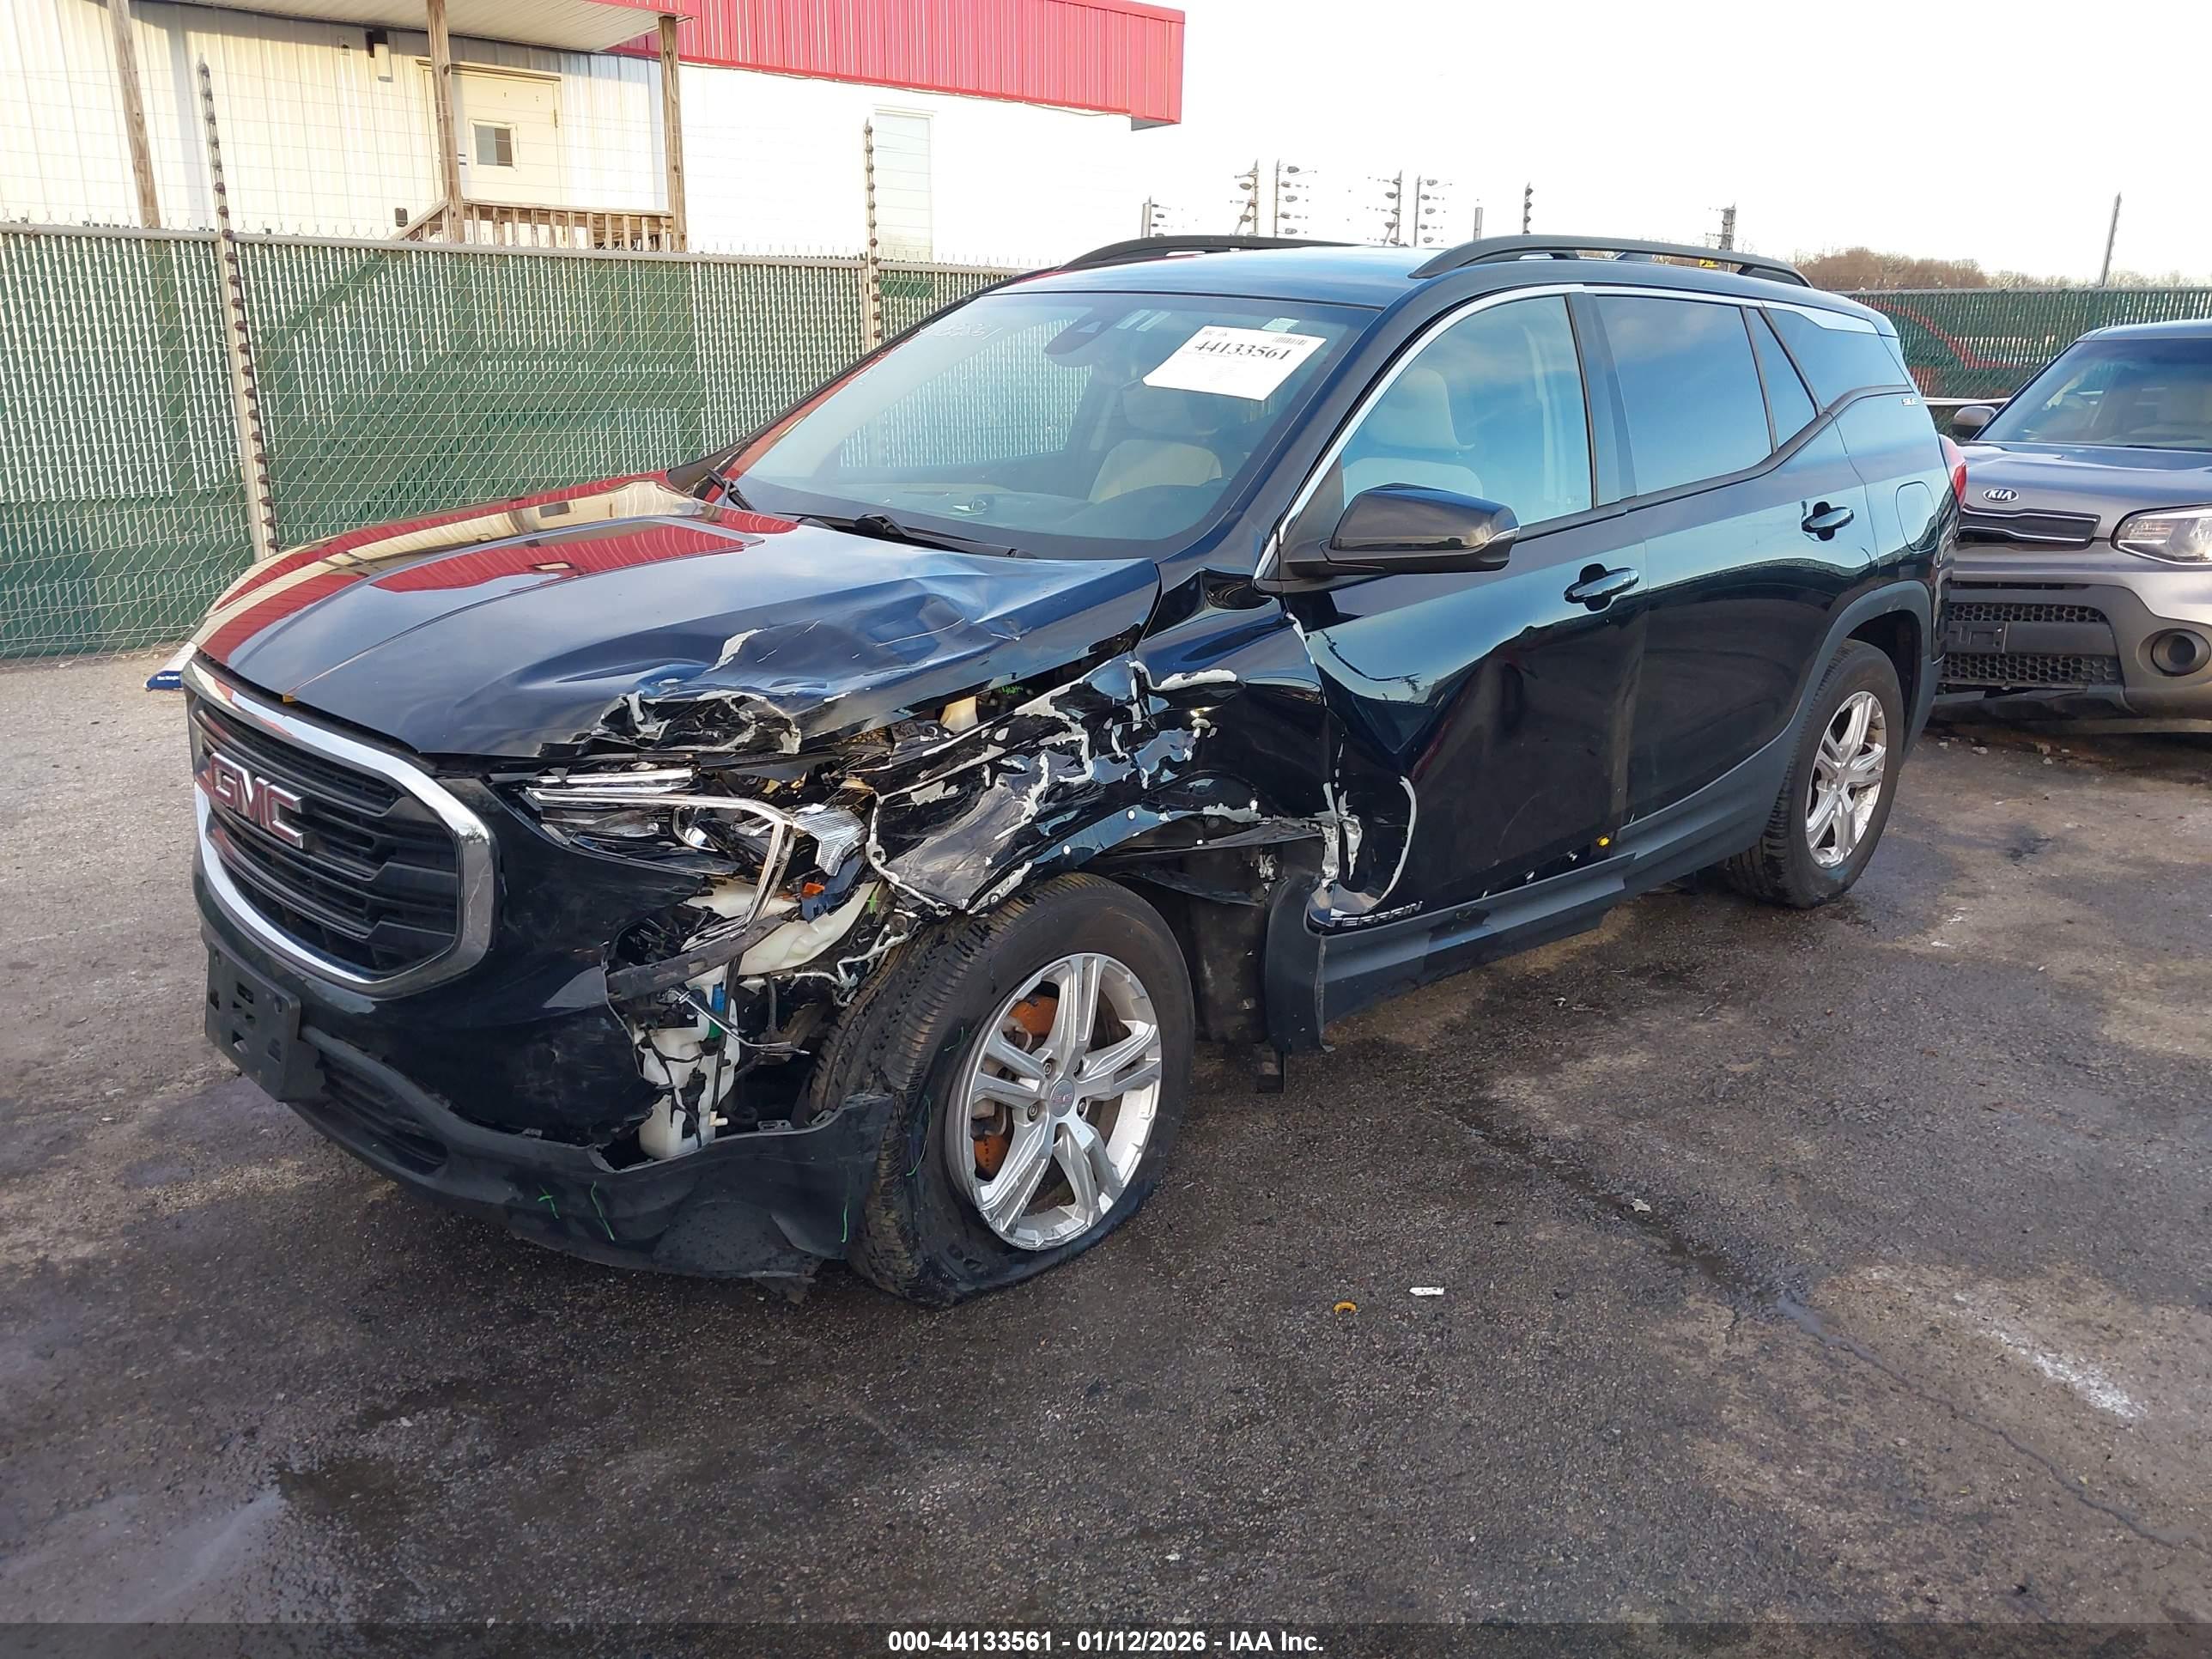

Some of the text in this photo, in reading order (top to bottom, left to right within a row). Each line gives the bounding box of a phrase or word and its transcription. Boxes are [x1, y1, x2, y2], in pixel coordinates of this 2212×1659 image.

[1194, 340, 1292, 361] 44133561
[1988, 489, 2013, 500] KIA
[210, 752, 303, 849] GMC
[1329, 900, 1424, 928] TERRAIN
